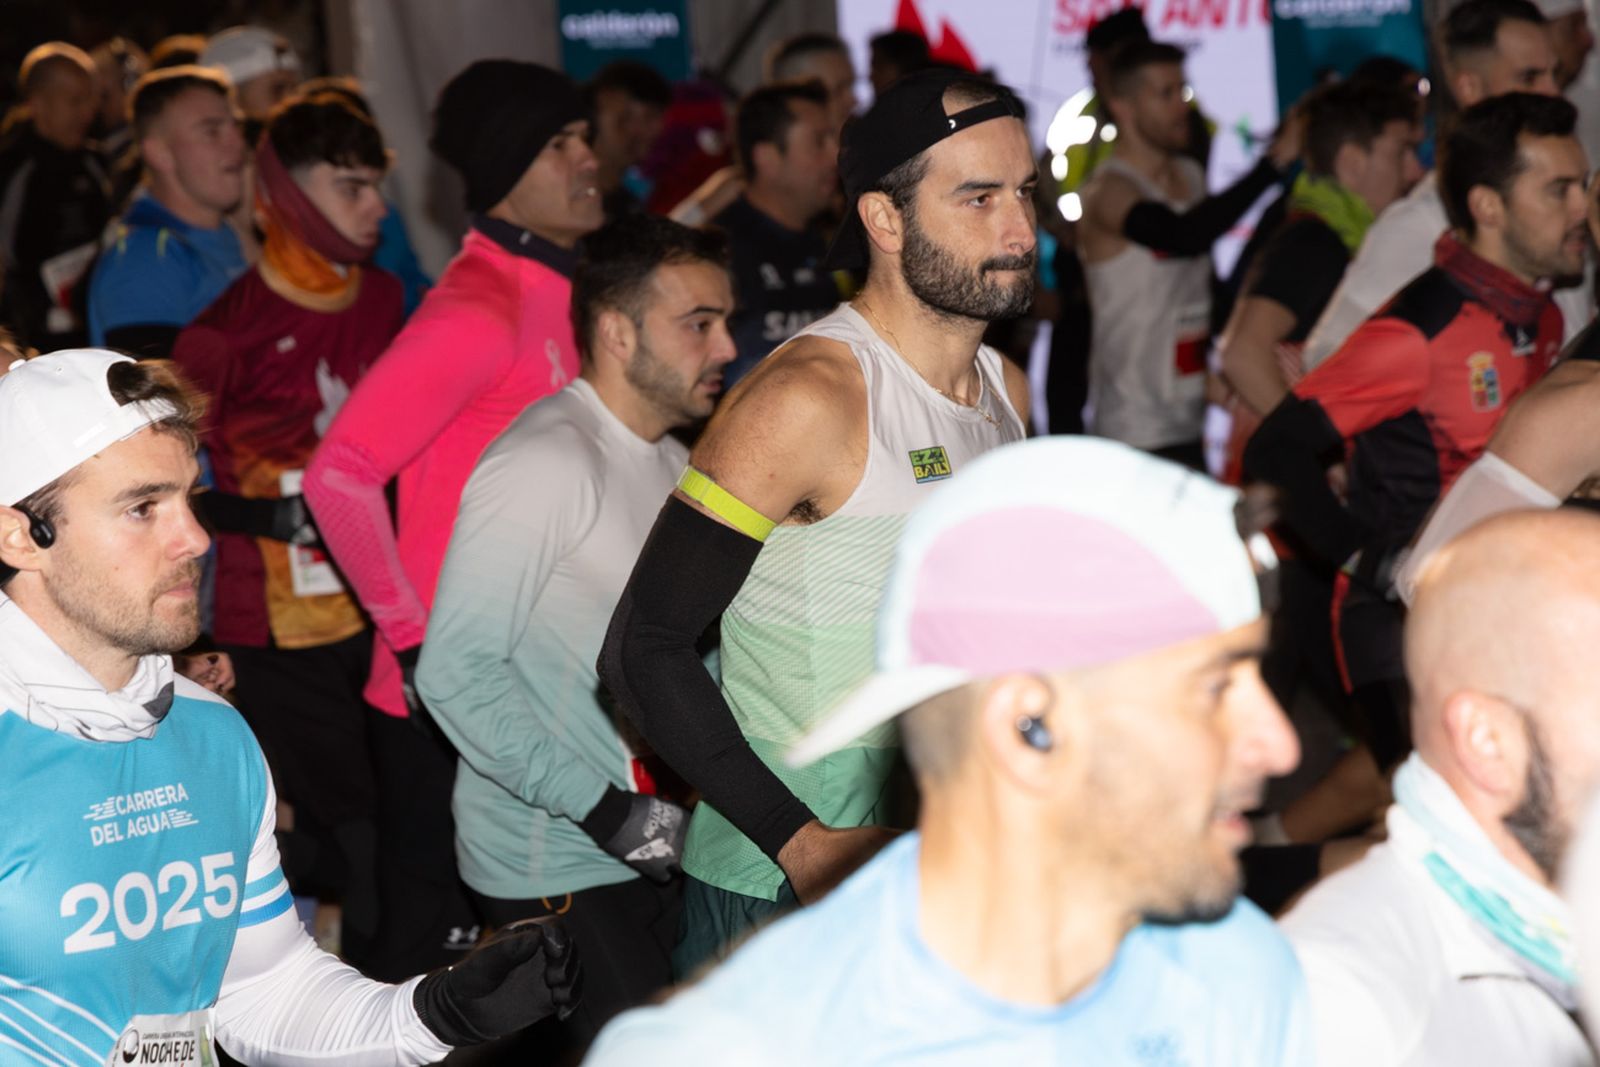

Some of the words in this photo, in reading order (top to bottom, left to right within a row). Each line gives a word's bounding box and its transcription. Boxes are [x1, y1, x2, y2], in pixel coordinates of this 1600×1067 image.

[115, 783, 189, 815] CARRERA
[90, 822, 124, 847] DEL
[127, 812, 171, 838] AGUA
[60, 852, 238, 955] 2025
[140, 1041, 180, 1064] NOCHE
[181, 1040, 195, 1061] DE
